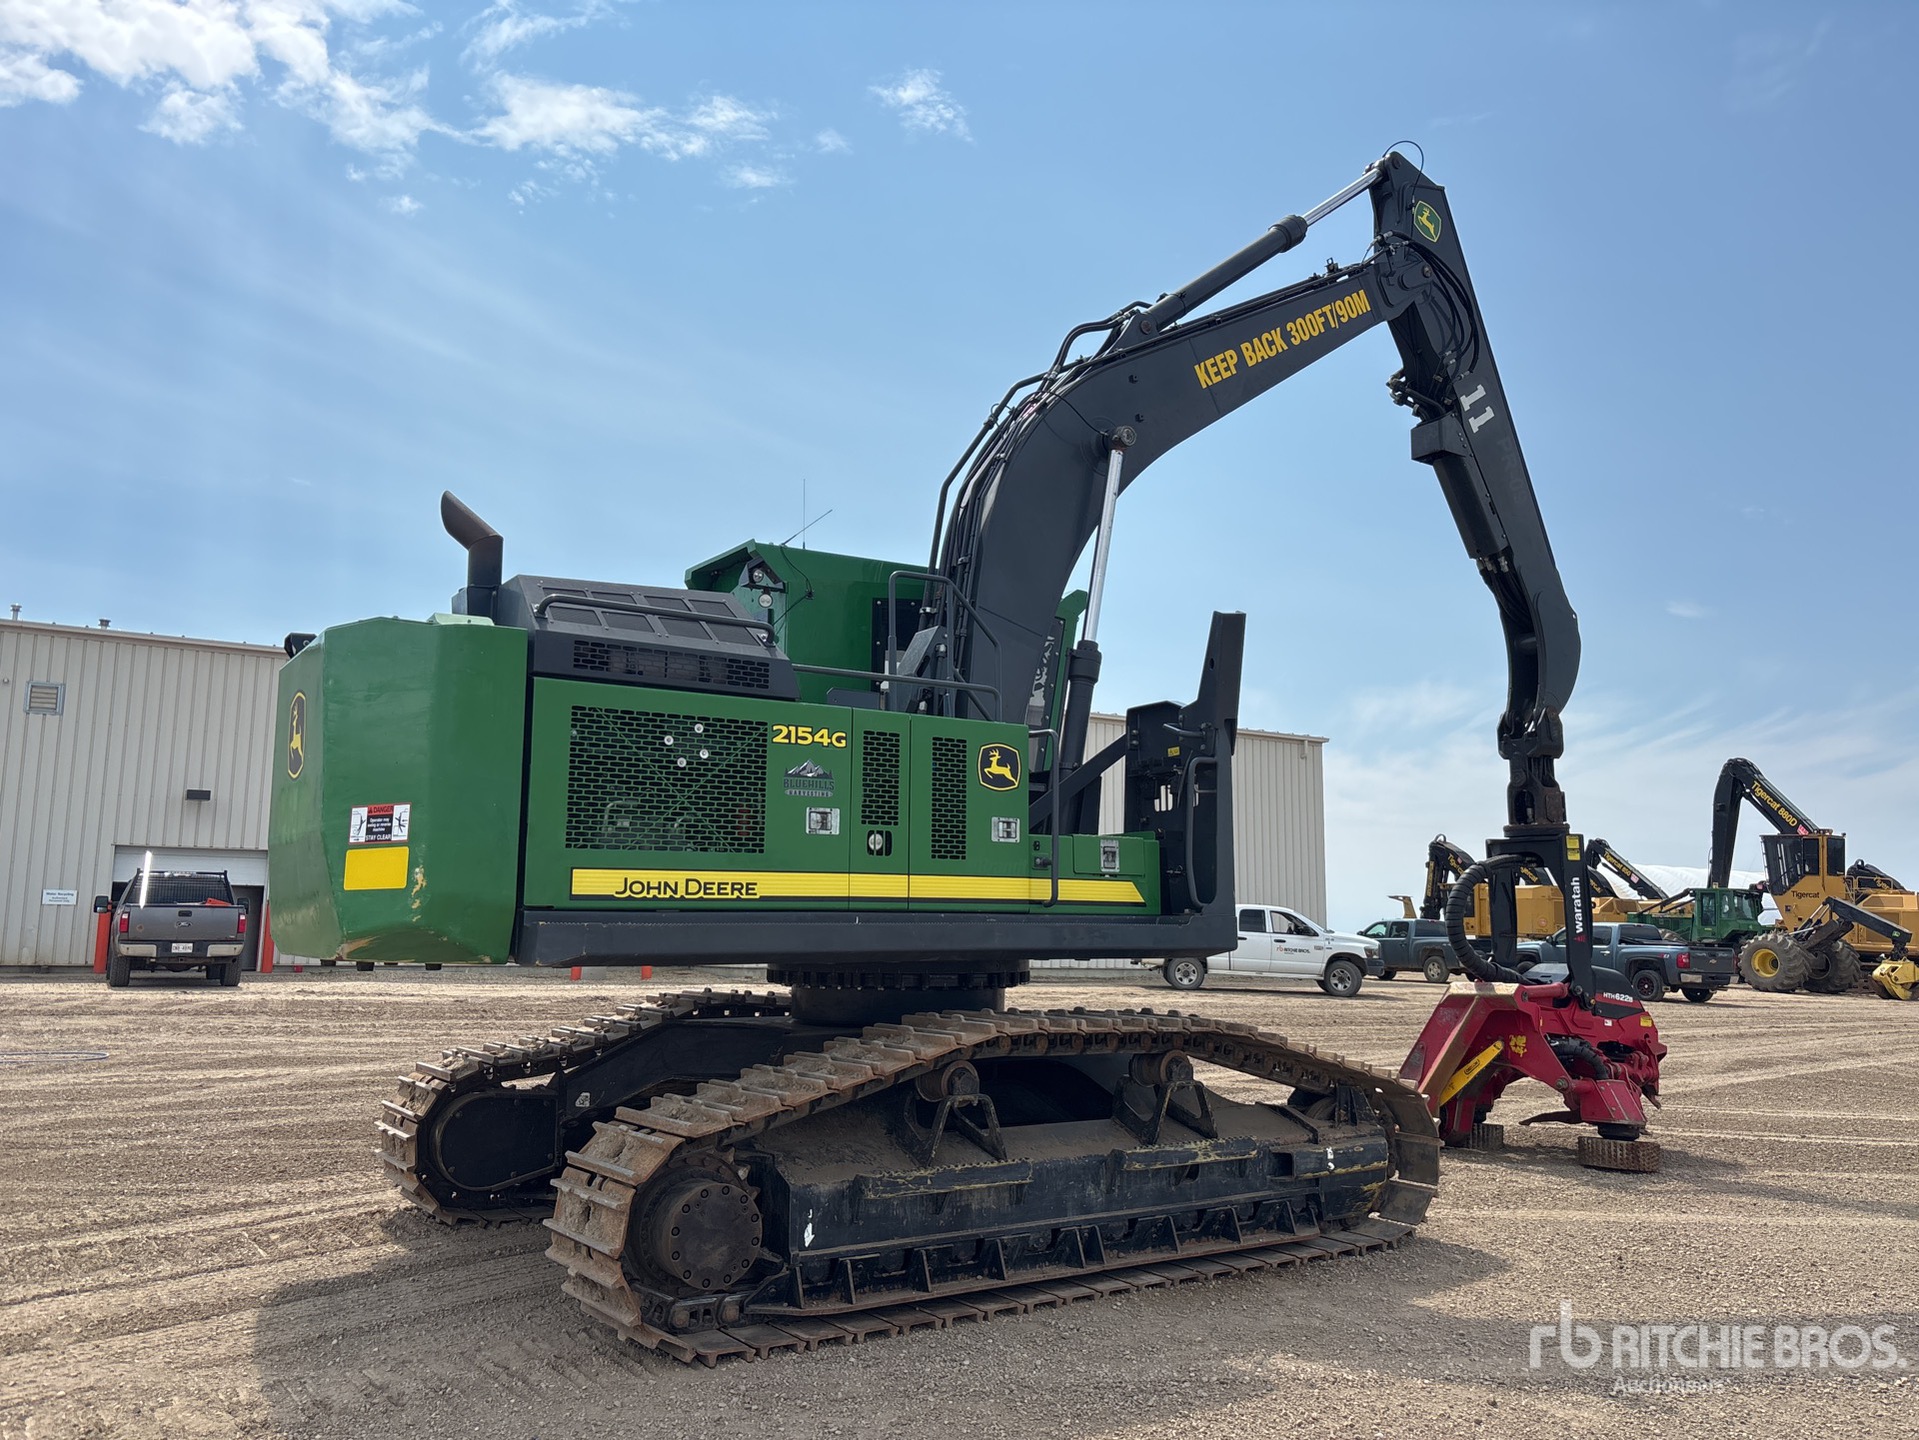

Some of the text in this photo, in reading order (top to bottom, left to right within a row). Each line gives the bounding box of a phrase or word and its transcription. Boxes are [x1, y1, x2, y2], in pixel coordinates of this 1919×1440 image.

[1193, 289, 1371, 389] KEEP BACK 300FT/90M
[1460, 384, 1495, 434] 11
[772, 724, 847, 748] 2154G
[784, 778, 834, 790] BLUEHILLS
[1752, 781, 1798, 827] Tigercat 880D
[615, 877, 757, 896] JOHN DEERE
[1791, 890, 1820, 899] Tigercat
[1570, 876, 1584, 934] waratah
